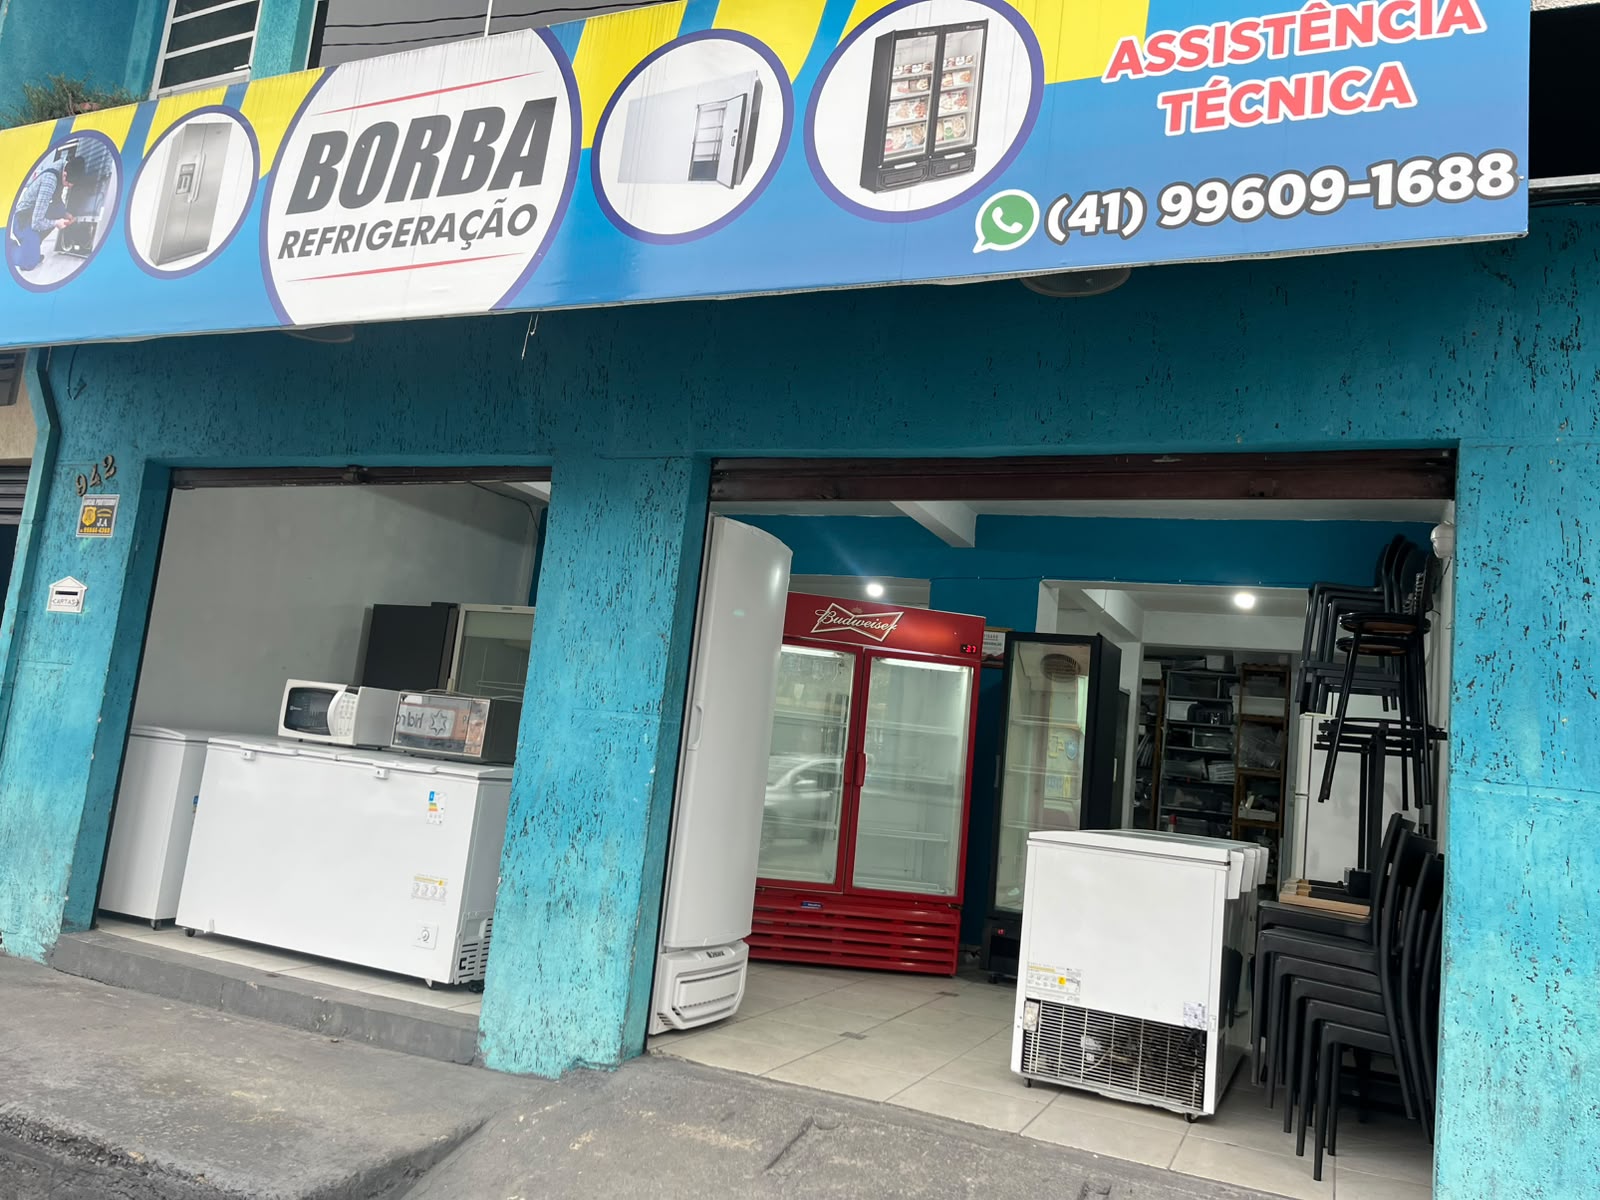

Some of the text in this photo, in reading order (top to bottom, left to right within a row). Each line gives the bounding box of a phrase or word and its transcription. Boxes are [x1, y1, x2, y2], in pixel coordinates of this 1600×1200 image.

[1104, 0, 1485, 81] ASSISTÊNCIA
[1159, 63, 1414, 134] TÉCNICA
[285, 96, 557, 215] BORBA
[278, 197, 538, 260] REFRIGERAÇÃO
[1046, 149, 1517, 244] (41) 99609-1688
[76, 455, 116, 496] 942
[815, 609, 897, 631] Budweiser
